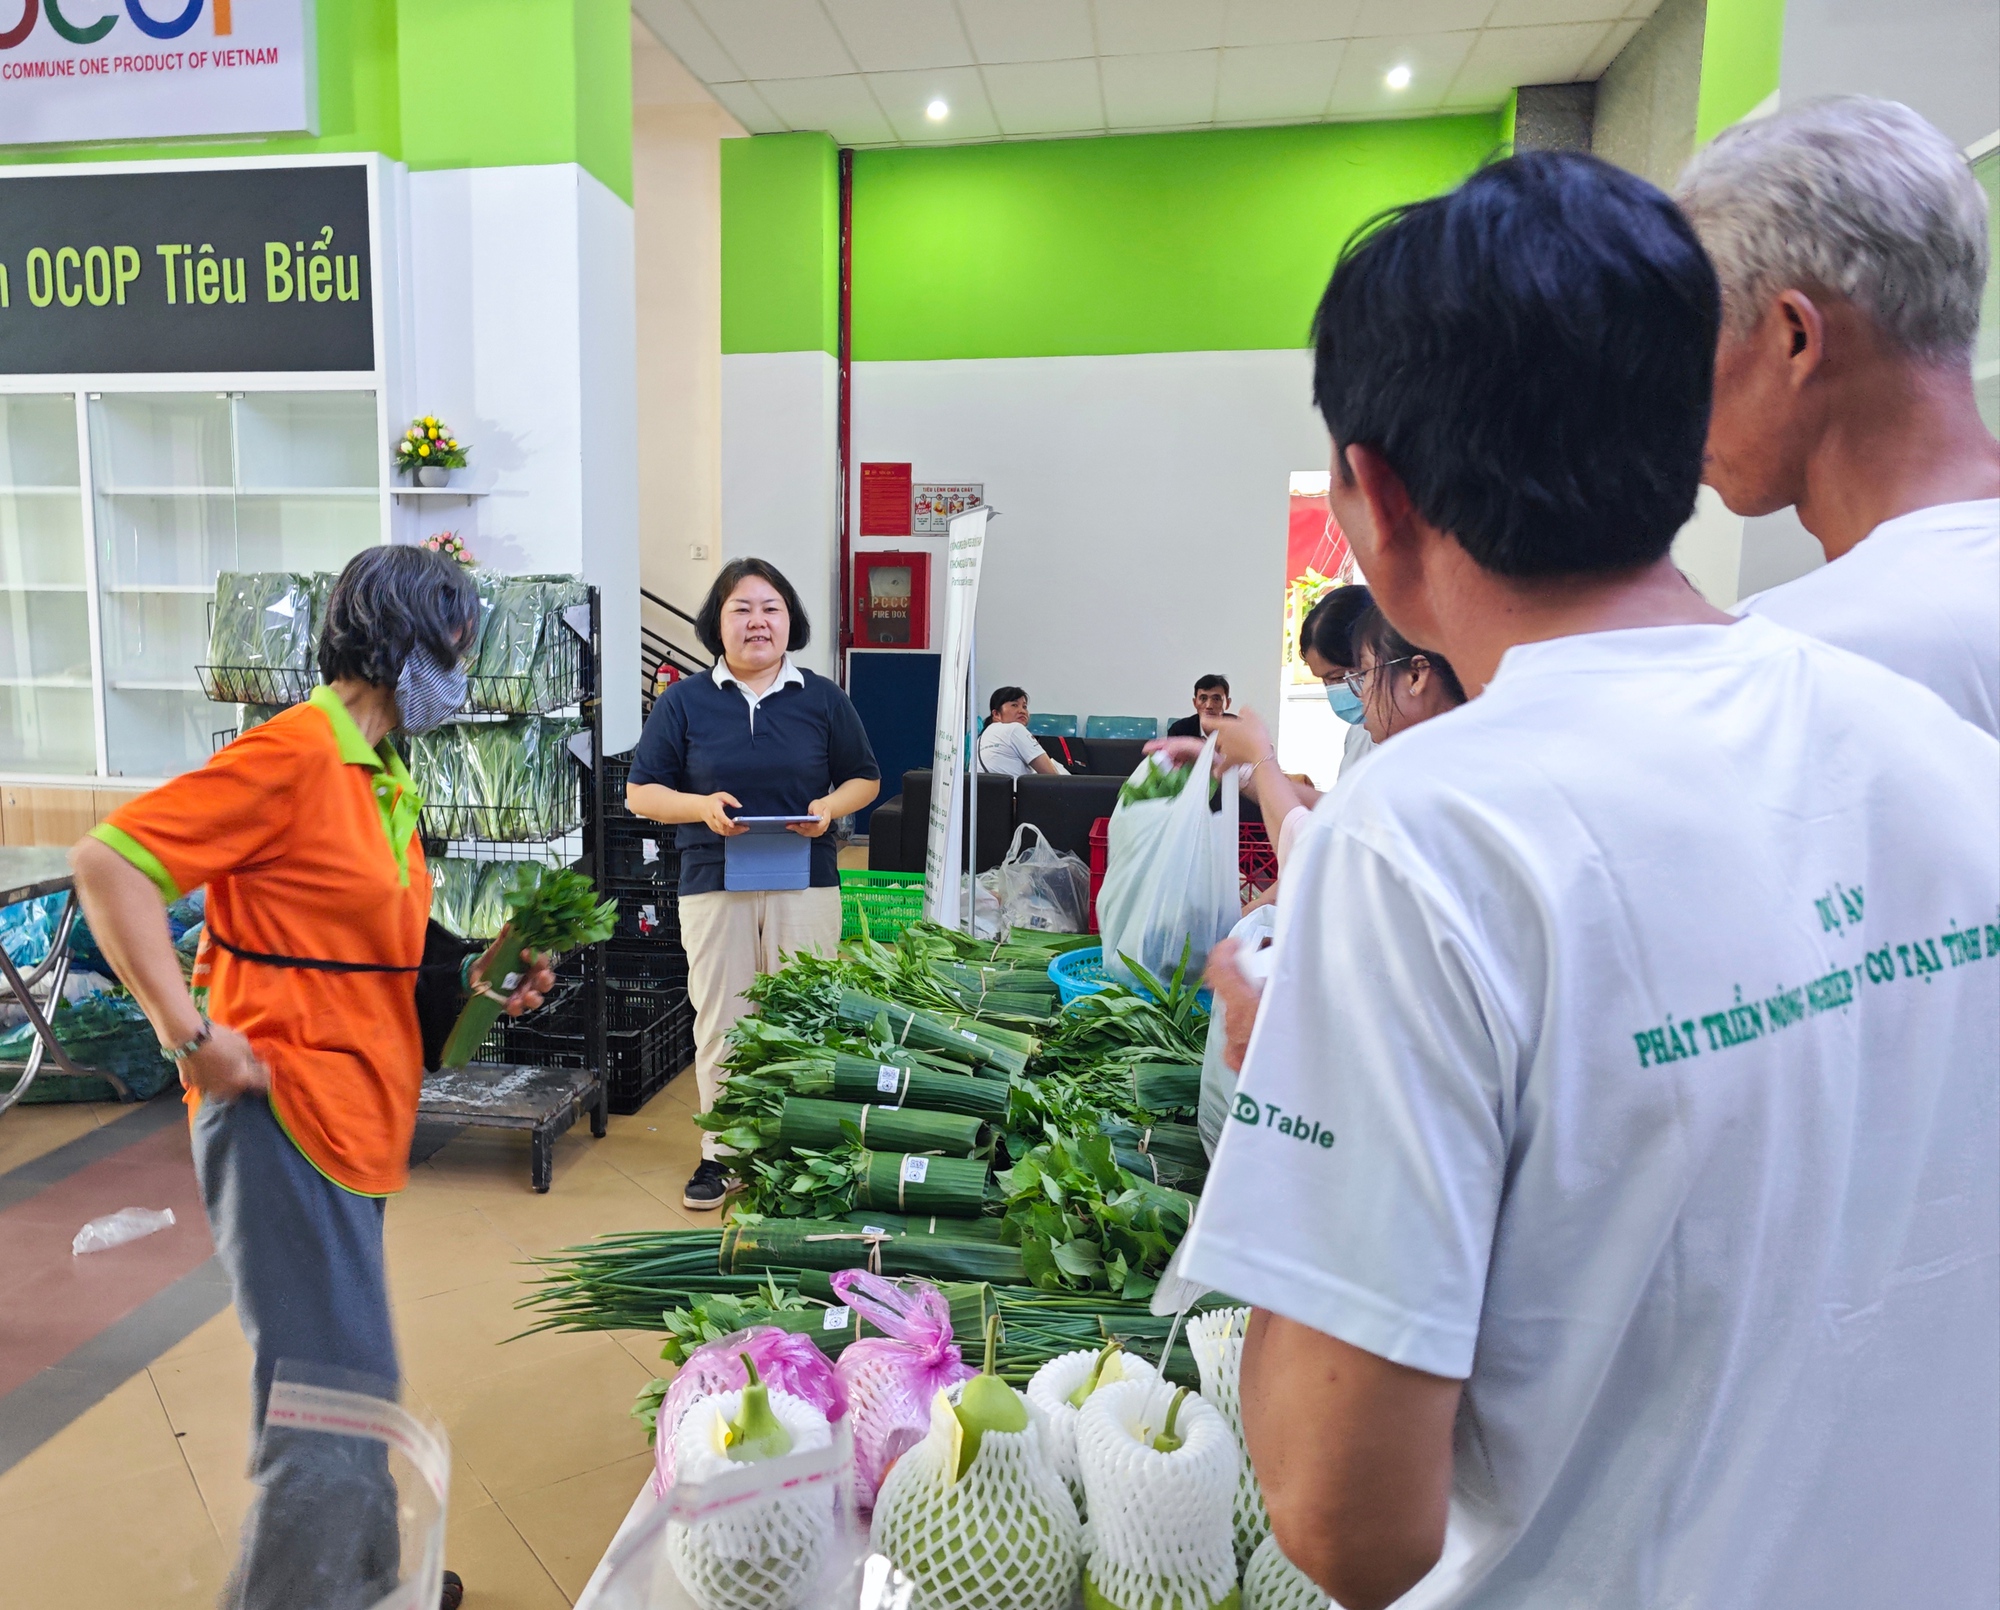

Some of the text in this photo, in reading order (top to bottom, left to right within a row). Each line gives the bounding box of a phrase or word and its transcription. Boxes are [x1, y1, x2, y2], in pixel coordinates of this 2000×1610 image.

[2, 47, 278, 79] COMMUNE ONE PRODUCT OF VIETNAM
[26, 245, 141, 307] OCOP
[156, 244, 246, 304] Tiêu
[265, 225, 360, 303] Biểu
[871, 596, 908, 609] PCCC
[872, 610, 907, 619] FIRE BOX
[1633, 1012, 1700, 1068] PHÁT
[1265, 1103, 1335, 1149] Table
